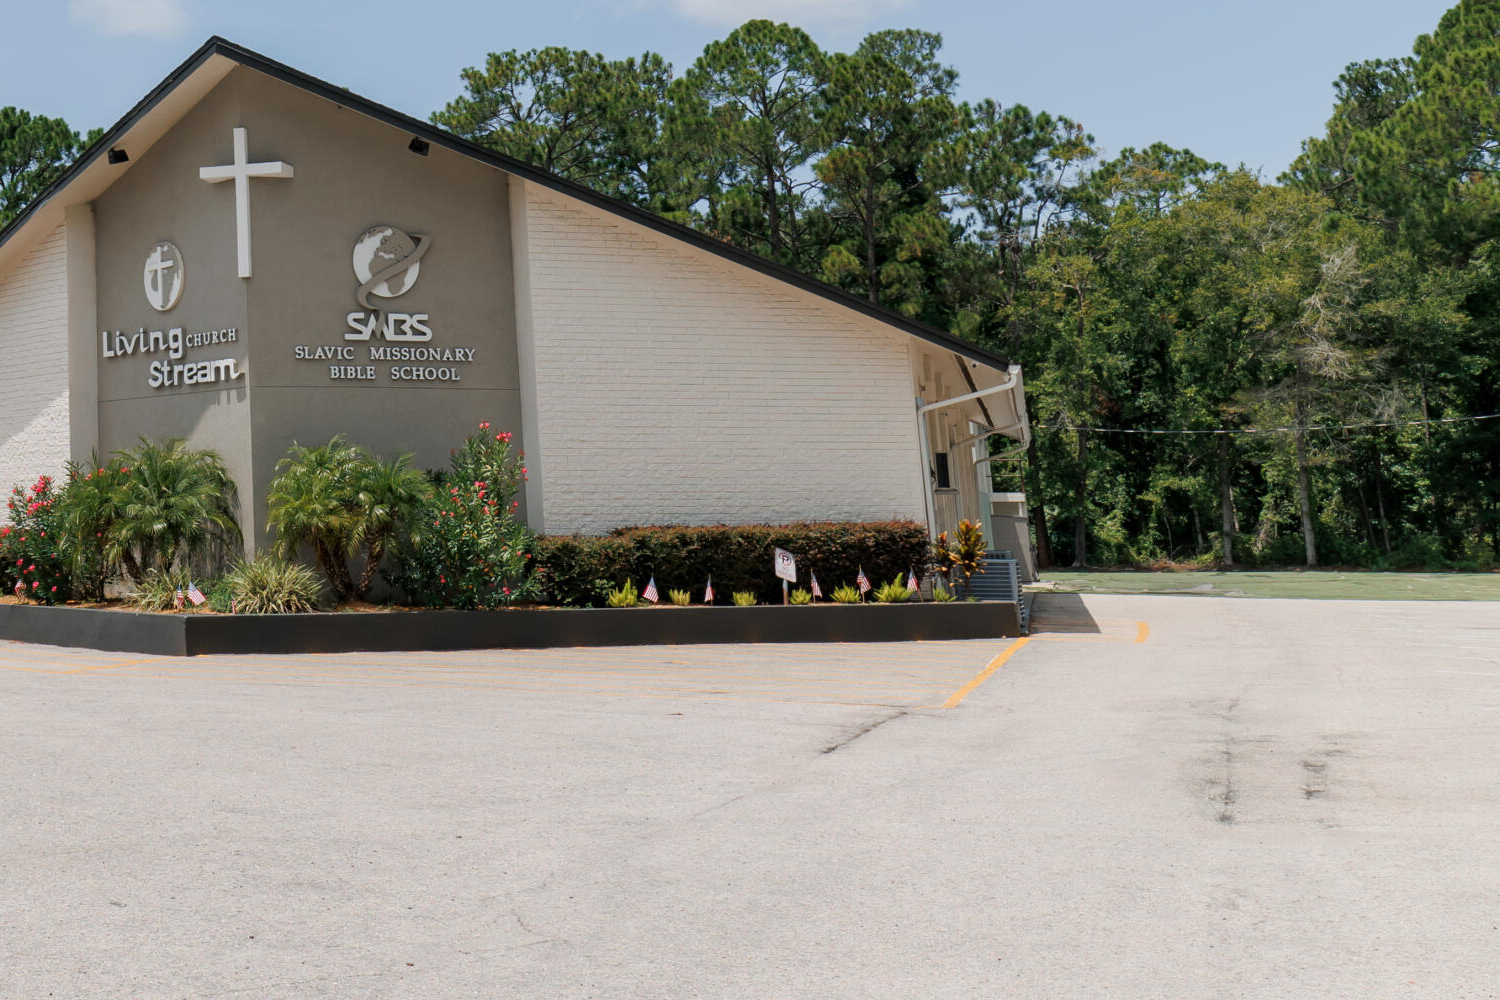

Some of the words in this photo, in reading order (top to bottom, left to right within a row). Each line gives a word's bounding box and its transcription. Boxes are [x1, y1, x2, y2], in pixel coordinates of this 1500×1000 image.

[102, 327, 183, 360] Living
[185, 328, 237, 347] CHURCH
[295, 346, 355, 360] SLAVIC
[370, 347, 476, 362] MISSIONARY
[148, 358, 246, 388] Stream
[330, 366, 376, 380] BIBLE
[391, 367, 461, 381] SCHOOL
